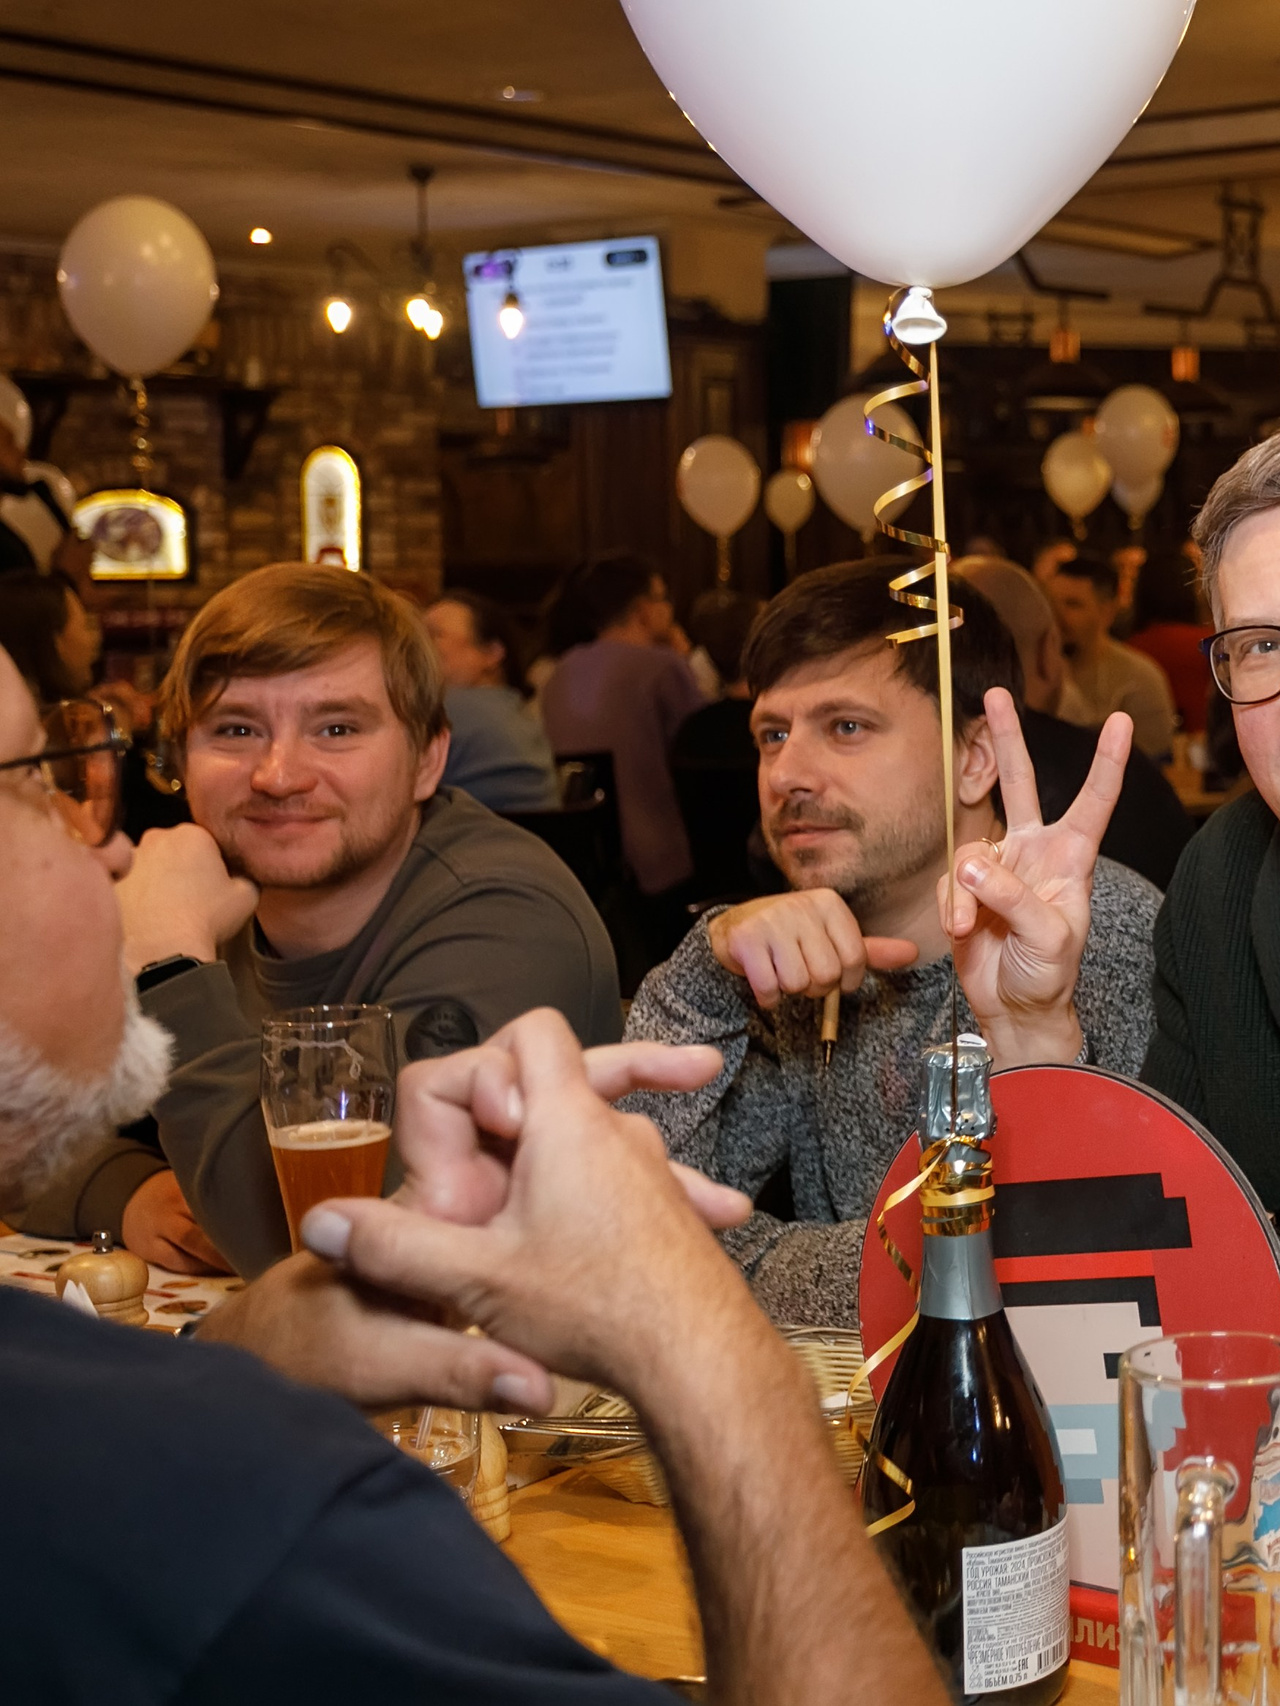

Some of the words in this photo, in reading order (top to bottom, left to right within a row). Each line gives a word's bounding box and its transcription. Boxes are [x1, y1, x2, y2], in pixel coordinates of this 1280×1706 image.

[966, 1566, 980, 1579] ГОД
[1070, 1619, 1120, 1651] ЛИ
[1009, 1672, 1022, 1685] 0,75
